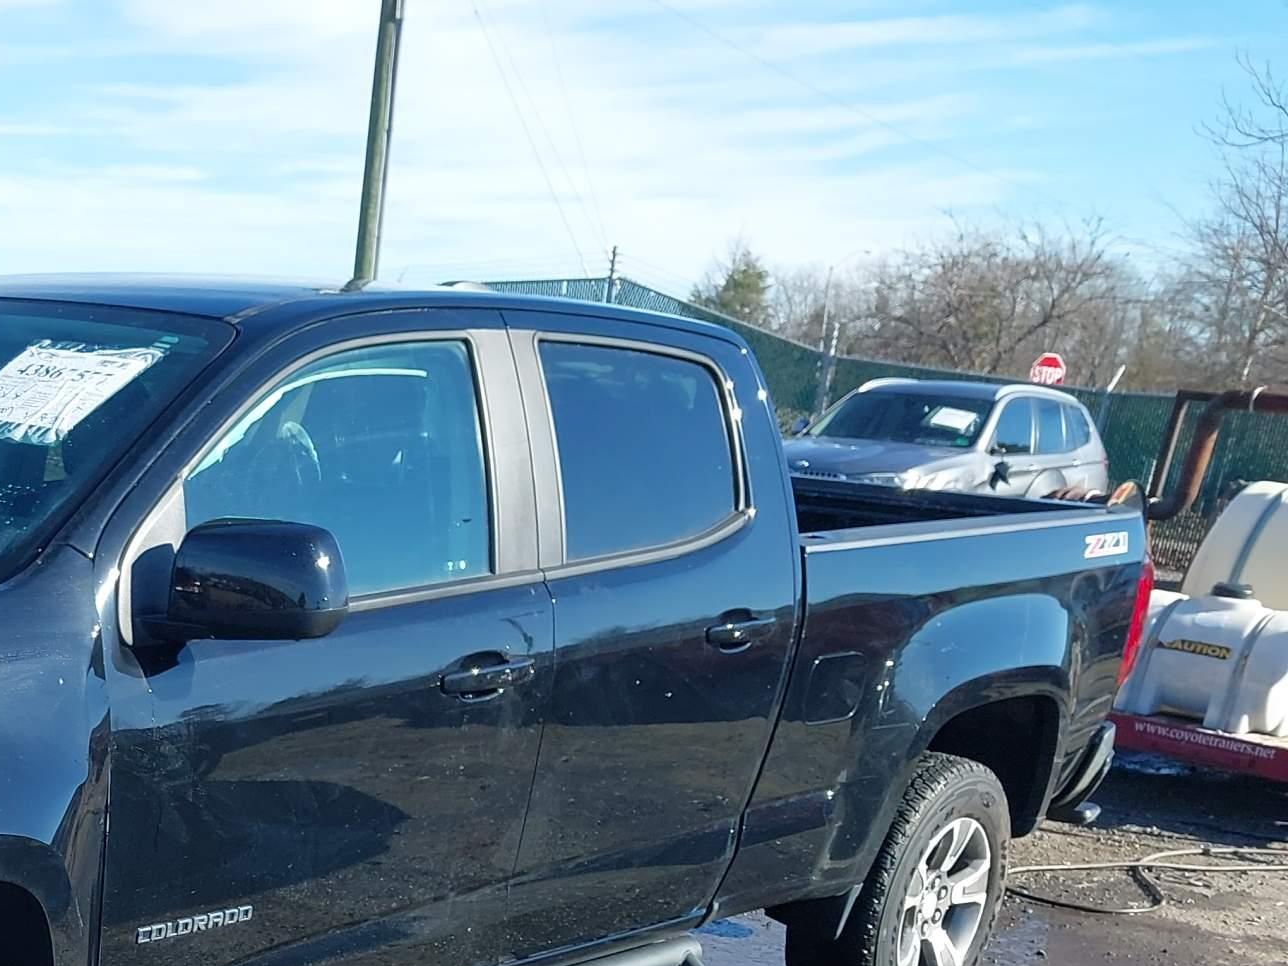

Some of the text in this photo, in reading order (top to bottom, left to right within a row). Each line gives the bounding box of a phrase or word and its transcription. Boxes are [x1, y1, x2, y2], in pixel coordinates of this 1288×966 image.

[1033, 366, 1062, 385] STOP
[1165, 639, 1231, 659] AUTION
[1134, 721, 1277, 759] www.coyotetrailers.net
[137, 905, 254, 944] COLORADO
